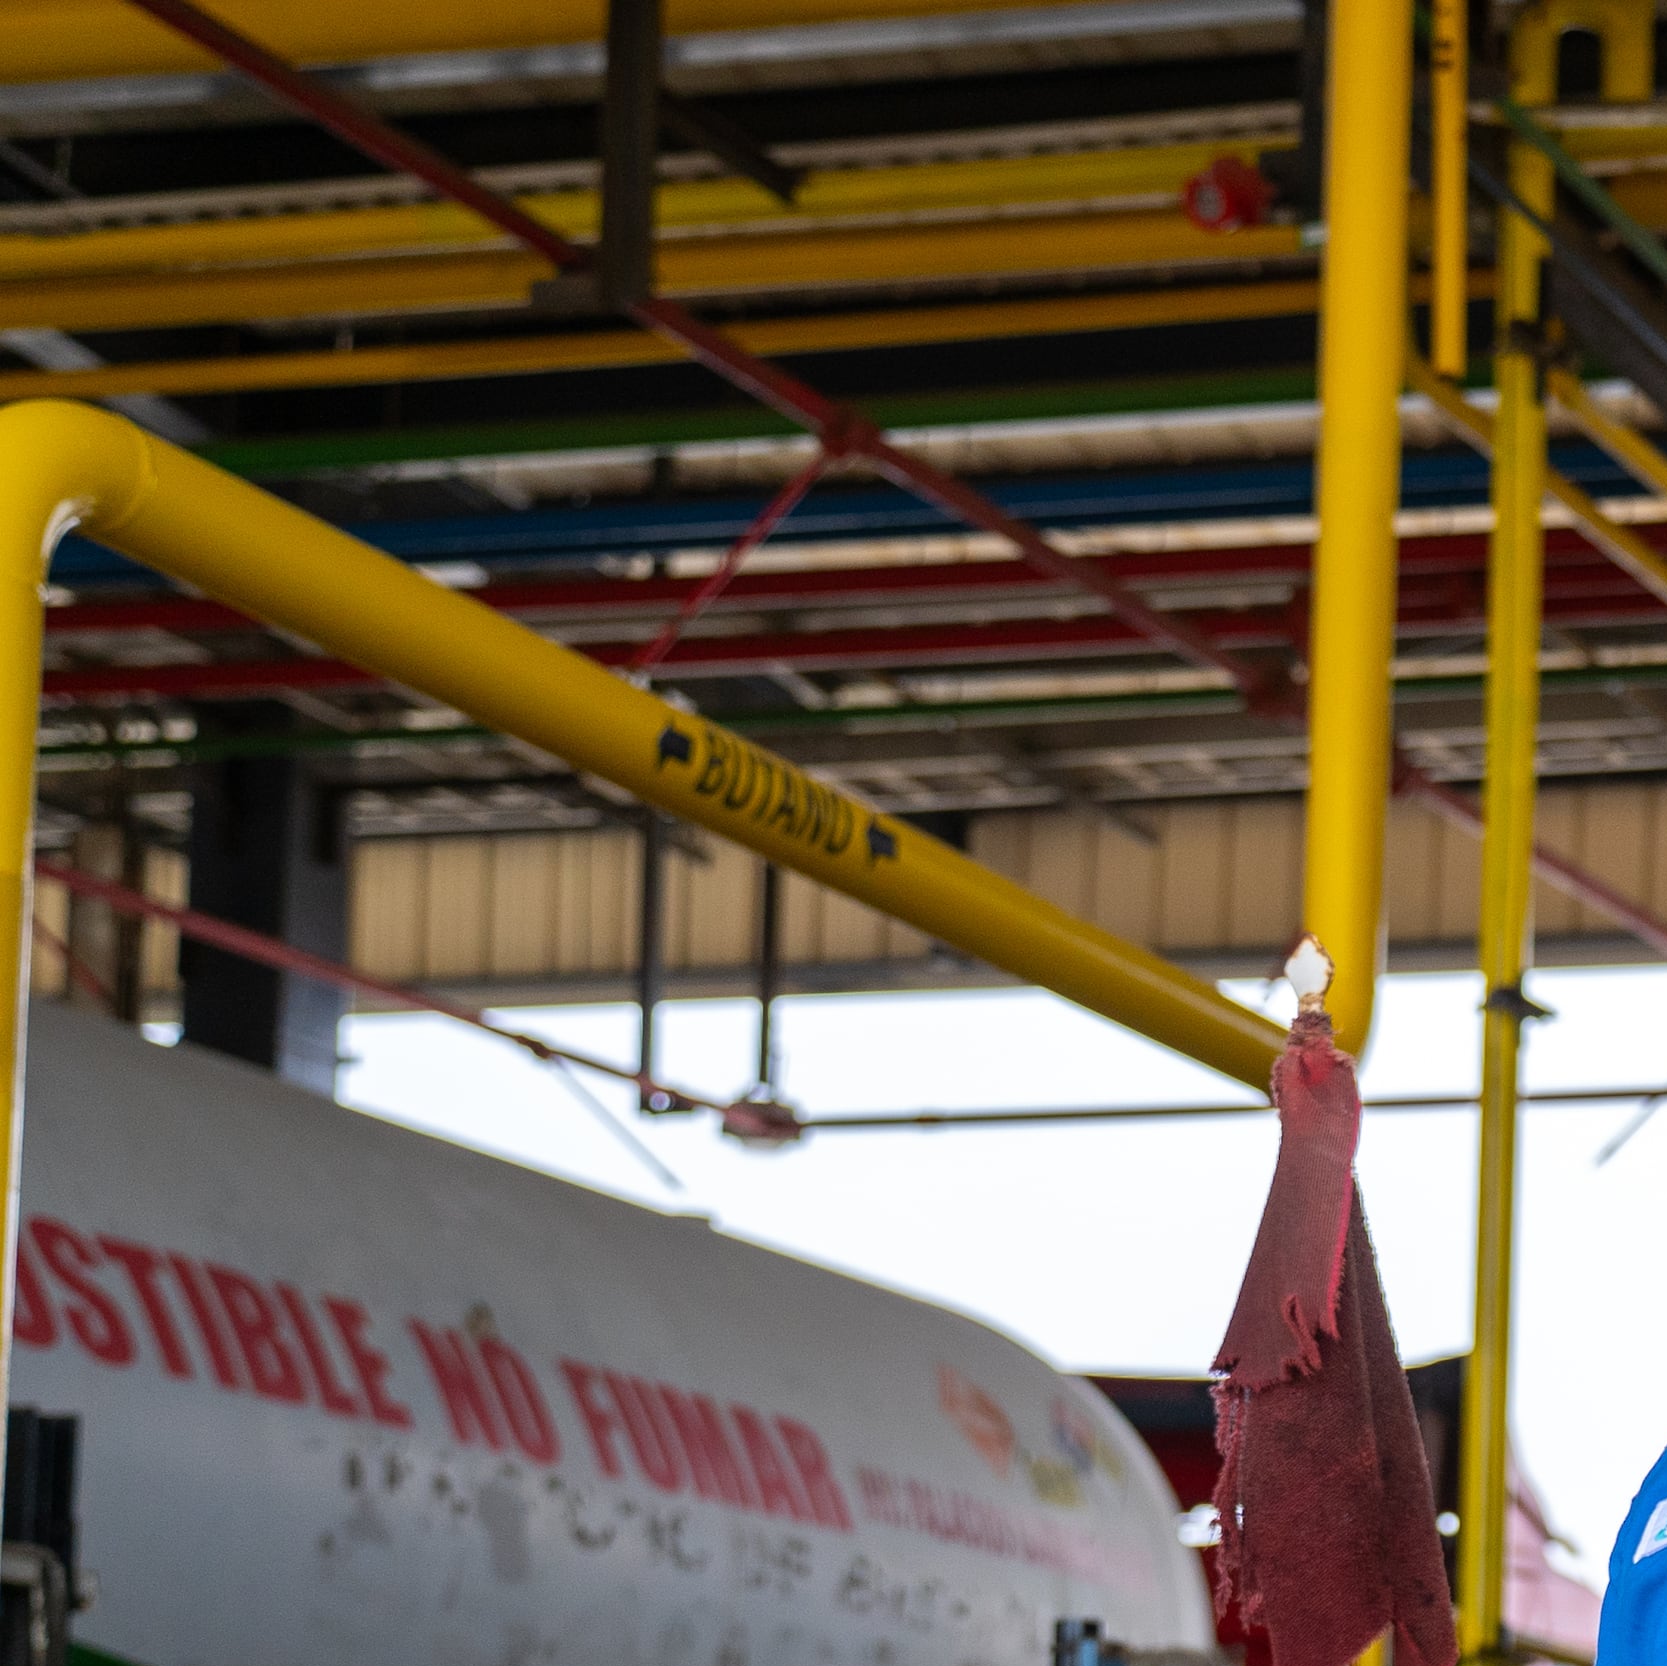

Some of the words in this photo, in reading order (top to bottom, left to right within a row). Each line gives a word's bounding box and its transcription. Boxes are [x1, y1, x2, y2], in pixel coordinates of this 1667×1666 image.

[696, 728, 854, 854] BUTANO
[404, 1314, 562, 1469] NO
[556, 1354, 854, 1534] FUMAR
